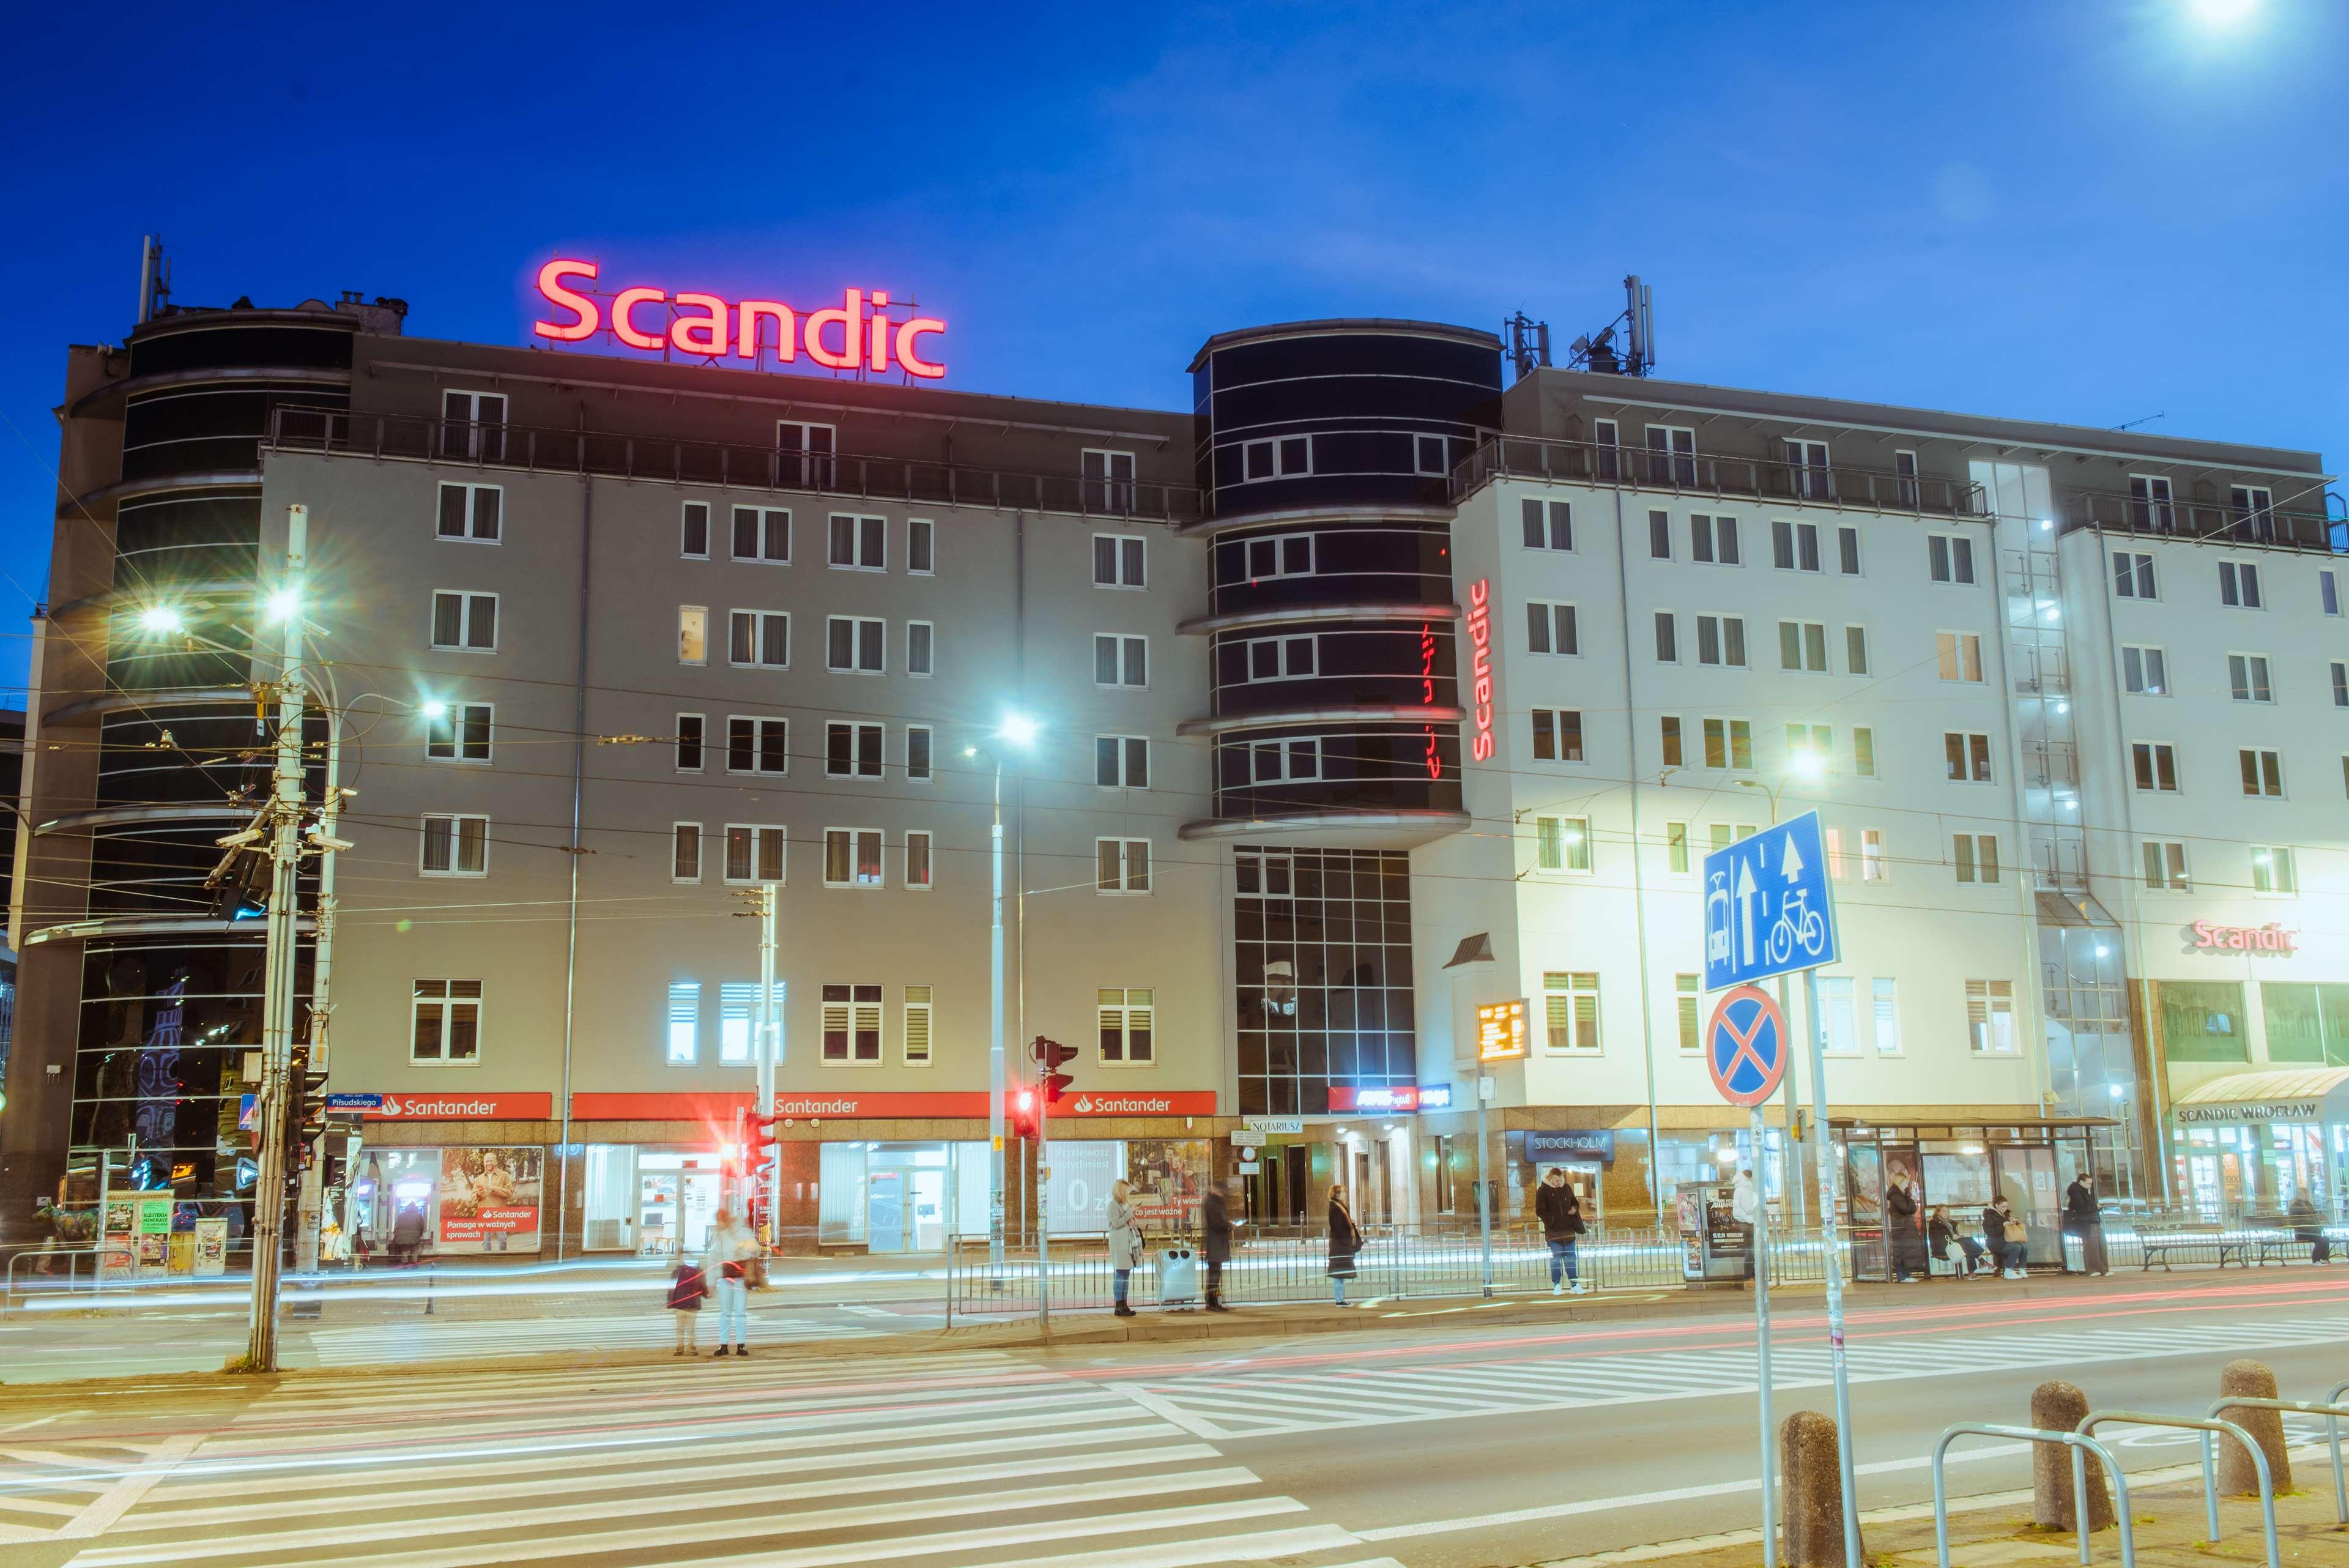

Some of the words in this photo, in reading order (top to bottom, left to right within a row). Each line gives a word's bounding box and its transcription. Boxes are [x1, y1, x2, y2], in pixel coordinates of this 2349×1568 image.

[534, 259, 945, 378] Scandic
[1468, 579, 1496, 762] Scandic
[2192, 920, 2300, 950] Scandic
[404, 1100, 497, 1115] Santander
[774, 1099, 858, 1113] Santander
[1095, 1098, 1171, 1112] Santander
[2179, 1108, 2238, 1123] SCANDIC
[2240, 1104, 2317, 1119] WROCŁAW
[1253, 1122, 1300, 1131] NOTARIUSZ
[1534, 1137, 1605, 1149] STOCKHOLM
[1056, 1146, 1110, 1157] Przelewasz
[1068, 1180, 1088, 1211] 0
[1172, 1197, 1181, 1206] Ty
[1145, 1208, 1157, 1217] jest
[447, 1221, 476, 1230] Pomaga
[486, 1221, 516, 1229] ważnych
[447, 1231, 480, 1239] sprawach
